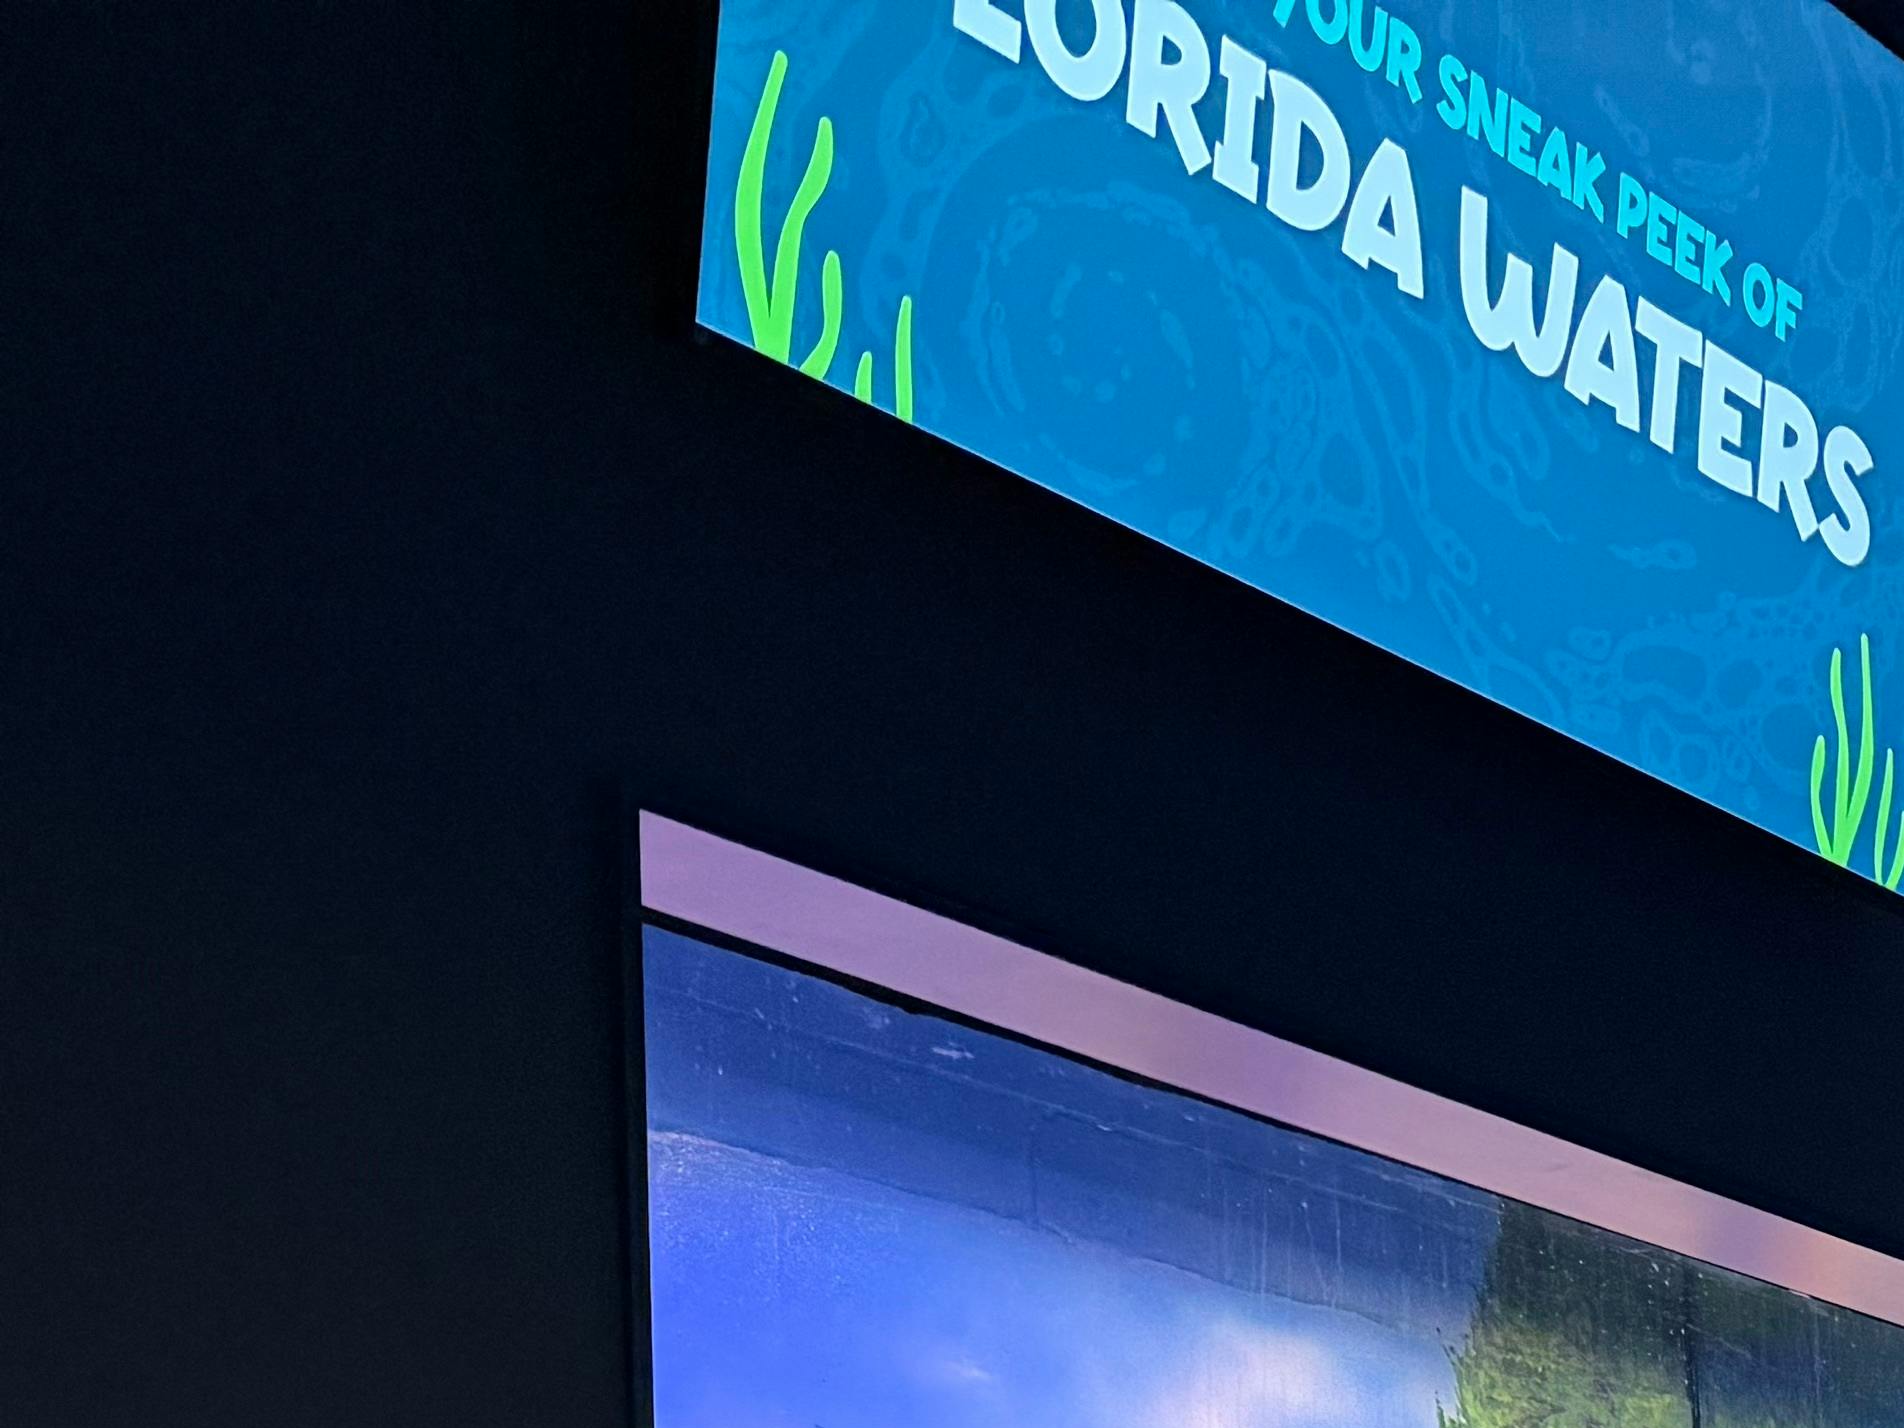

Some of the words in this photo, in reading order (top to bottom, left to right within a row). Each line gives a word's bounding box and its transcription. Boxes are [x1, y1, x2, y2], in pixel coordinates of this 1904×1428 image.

[1437, 55, 1606, 223] SNEAK
[1617, 173, 1734, 306] PEEK
[1743, 263, 1803, 341] OF
[1460, 186, 1873, 567] WATERS
